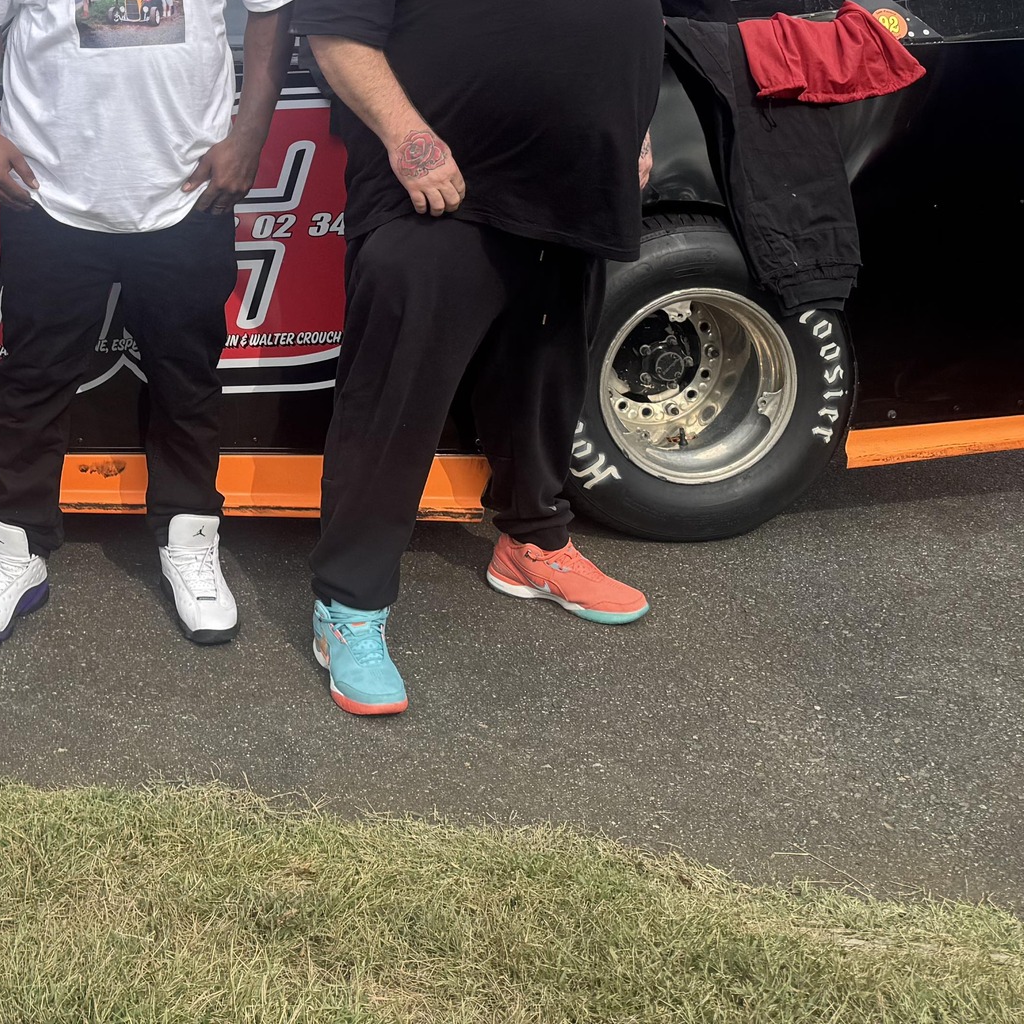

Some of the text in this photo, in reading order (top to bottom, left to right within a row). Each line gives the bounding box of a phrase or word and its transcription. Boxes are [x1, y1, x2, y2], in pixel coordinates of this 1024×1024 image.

[251, 214, 296, 239] 02
[308, 212, 345, 237] 34
[239, 334, 248, 347] &
[249, 332, 295, 346] WALTER
[296, 331, 342, 344] CROUCH
[799, 309, 848, 443] oosier
